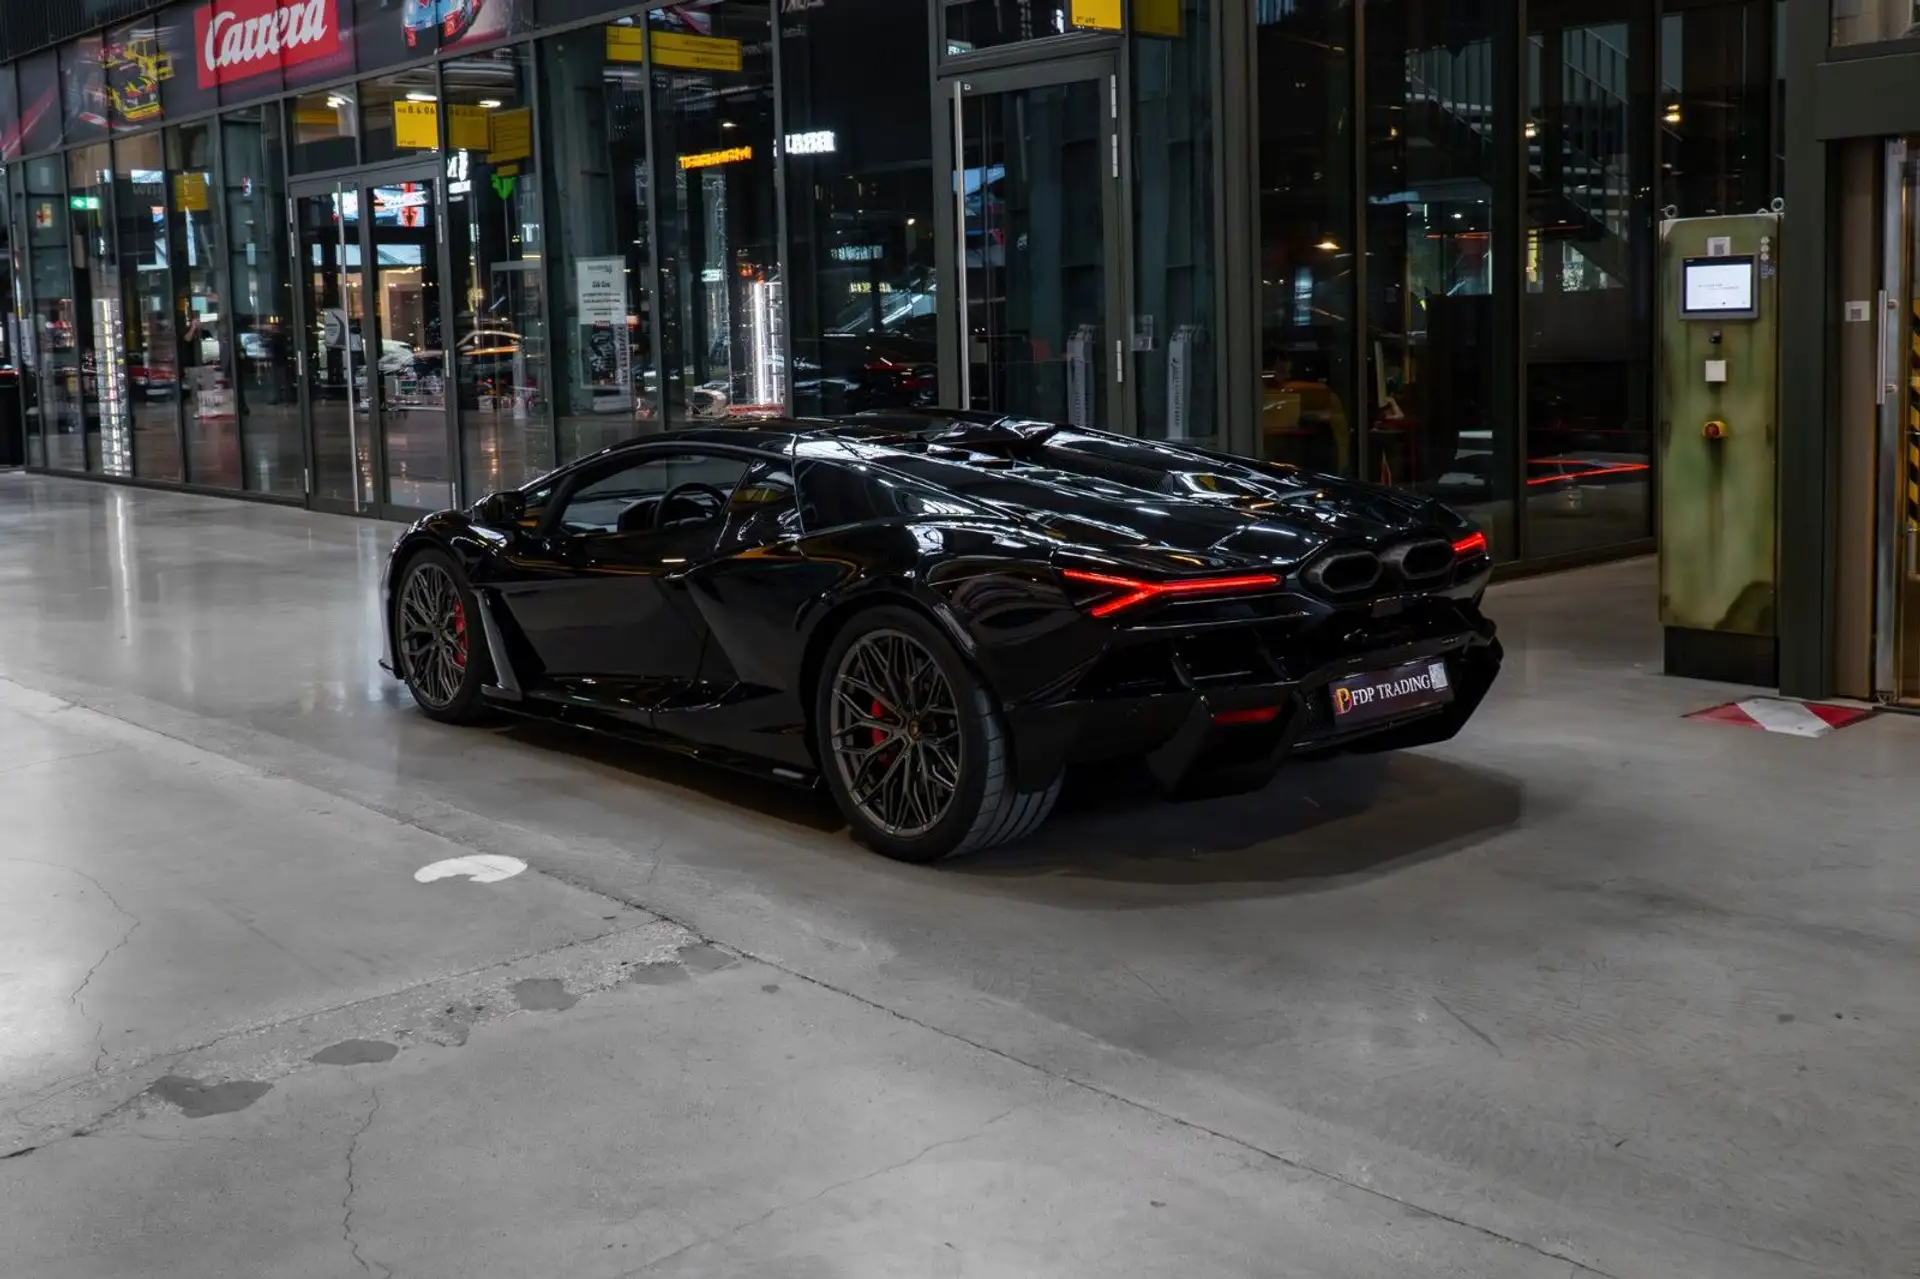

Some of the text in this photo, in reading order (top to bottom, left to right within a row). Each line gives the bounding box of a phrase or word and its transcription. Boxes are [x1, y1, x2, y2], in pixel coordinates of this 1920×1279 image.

[205, 0, 327, 71] Carrera
[1351, 687, 1375, 706] FDP
[1376, 674, 1431, 699] TRADING
